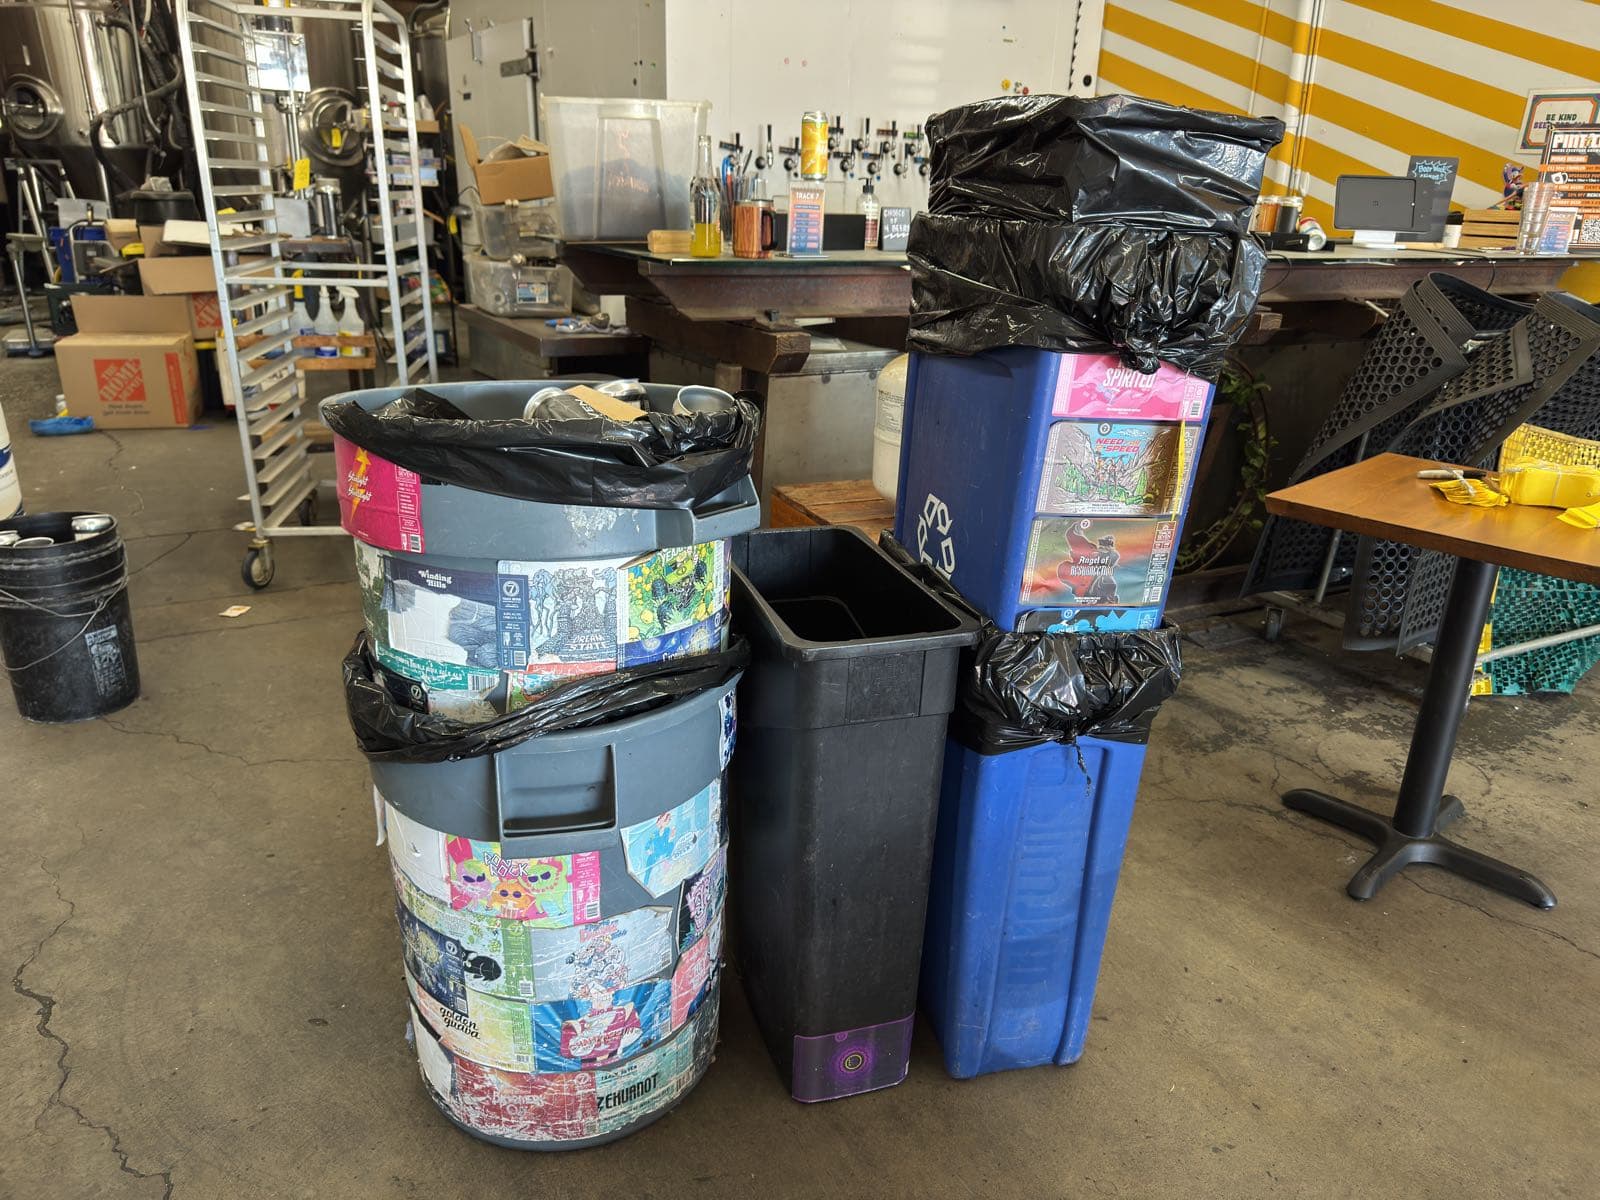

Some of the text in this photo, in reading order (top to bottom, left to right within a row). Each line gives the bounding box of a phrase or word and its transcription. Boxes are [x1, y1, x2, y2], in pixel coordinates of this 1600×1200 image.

[1545, 113, 1578, 121] BE KIND
[796, 191, 814, 200] TRACK
[100, 359, 141, 401] HOME
[1102, 367, 1157, 389] SPIRITED
[1105, 445, 1140, 453] SPEED
[1078, 555, 1110, 566] Angel of
[417, 569, 453, 584] Winding
[426, 579, 447, 589] Hills
[572, 633, 606, 644] DREAM
[566, 642, 609, 651] STATE
[489, 862, 529, 877] ROCK
[439, 1006, 479, 1030] golden
[444, 1016, 480, 1040] guava
